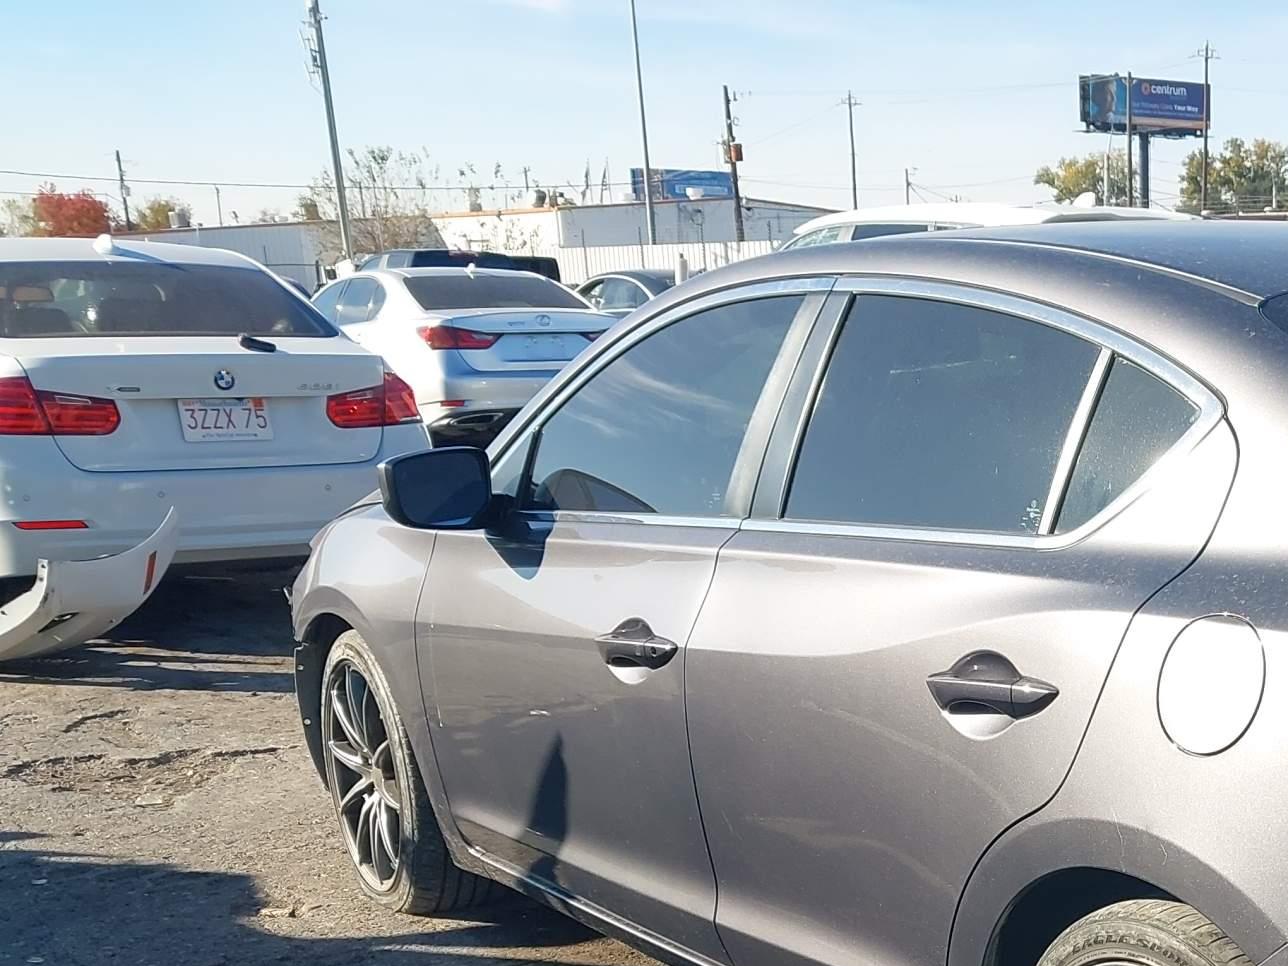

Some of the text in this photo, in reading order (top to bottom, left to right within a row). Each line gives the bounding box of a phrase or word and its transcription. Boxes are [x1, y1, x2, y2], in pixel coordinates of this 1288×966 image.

[1151, 84, 1187, 96] centrum
[184, 408, 268, 430] 3ZZX 75
